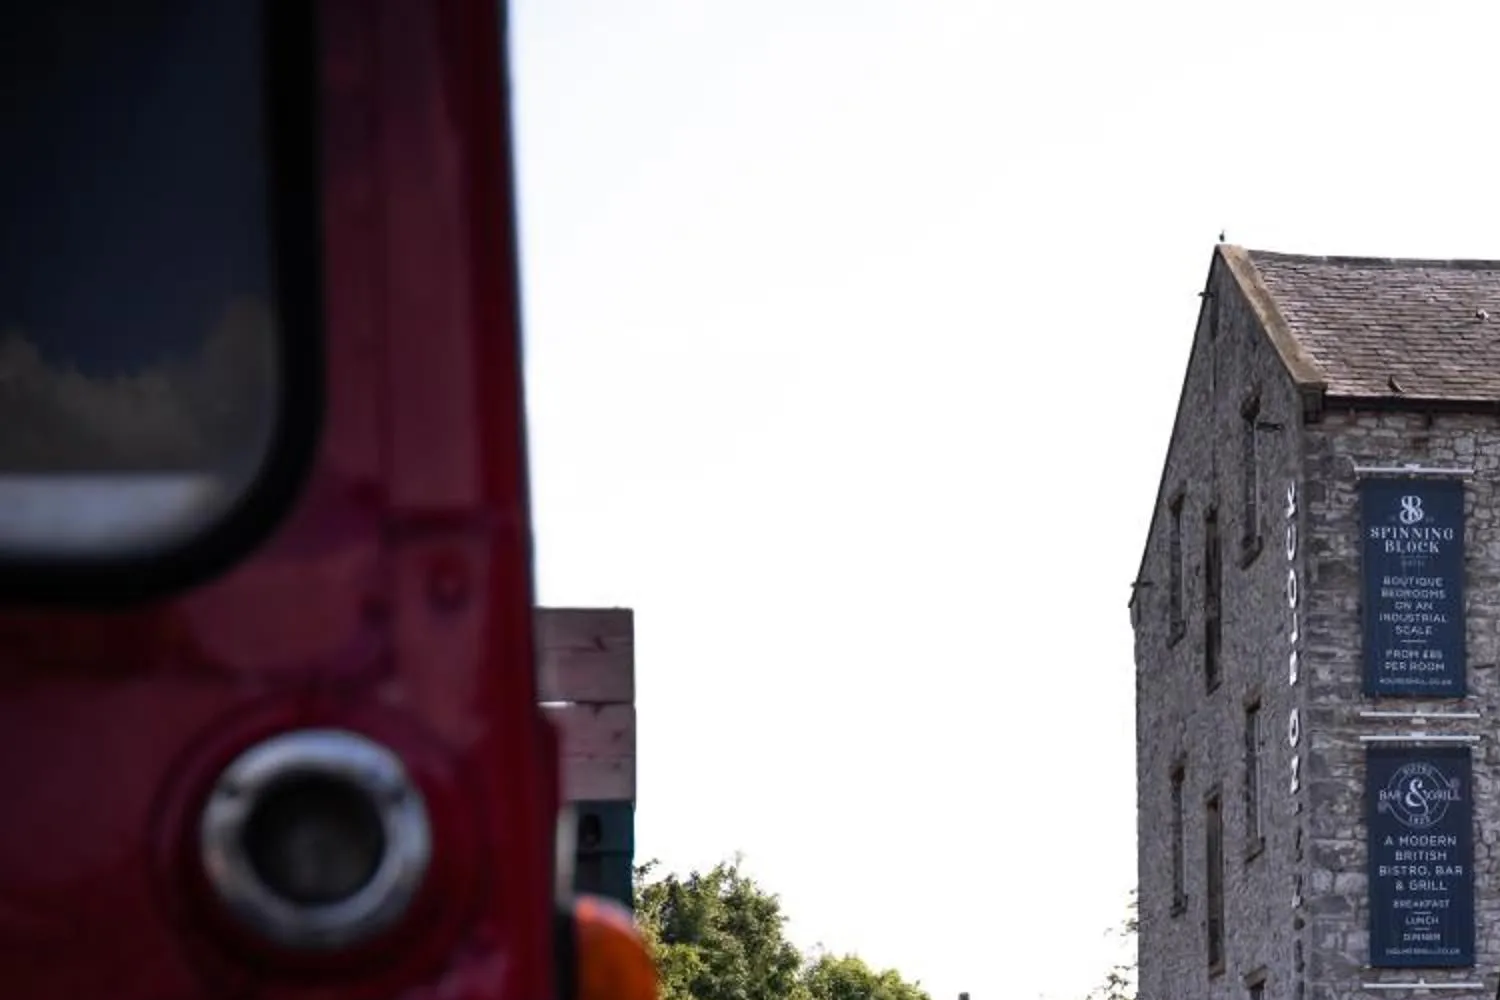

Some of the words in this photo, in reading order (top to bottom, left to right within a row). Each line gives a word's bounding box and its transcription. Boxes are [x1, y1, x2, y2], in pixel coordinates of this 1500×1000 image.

[1370, 526, 1454, 541] SPINNING
[1385, 540, 1440, 553] BLOCK
[1383, 576, 1444, 587] BOUTIQUE
[1381, 588, 1446, 600] BEDROOMS
[1395, 601, 1412, 610] ON
[1416, 601, 1433, 611] AN
[1379, 612, 1447, 624] INDUSTRIAL
[1395, 625, 1433, 636] SCALE
[1385, 649, 1420, 660] FROM
[1384, 661, 1407, 672] PER
[1409, 661, 1445, 672] ROOM
[1405, 777, 1429, 816] &
[1384, 835, 1394, 846] A
[1399, 835, 1457, 846] MODERN
[1395, 851, 1447, 862] BRITISH
[1379, 865, 1431, 877] BISTRO,
[1435, 865, 1463, 876] BAR
[1395, 881, 1403, 891] &
[1409, 880, 1447, 891] GRILL
[1393, 899, 1450, 909] BREAKFAST
[1405, 916, 1439, 925] LUNCH
